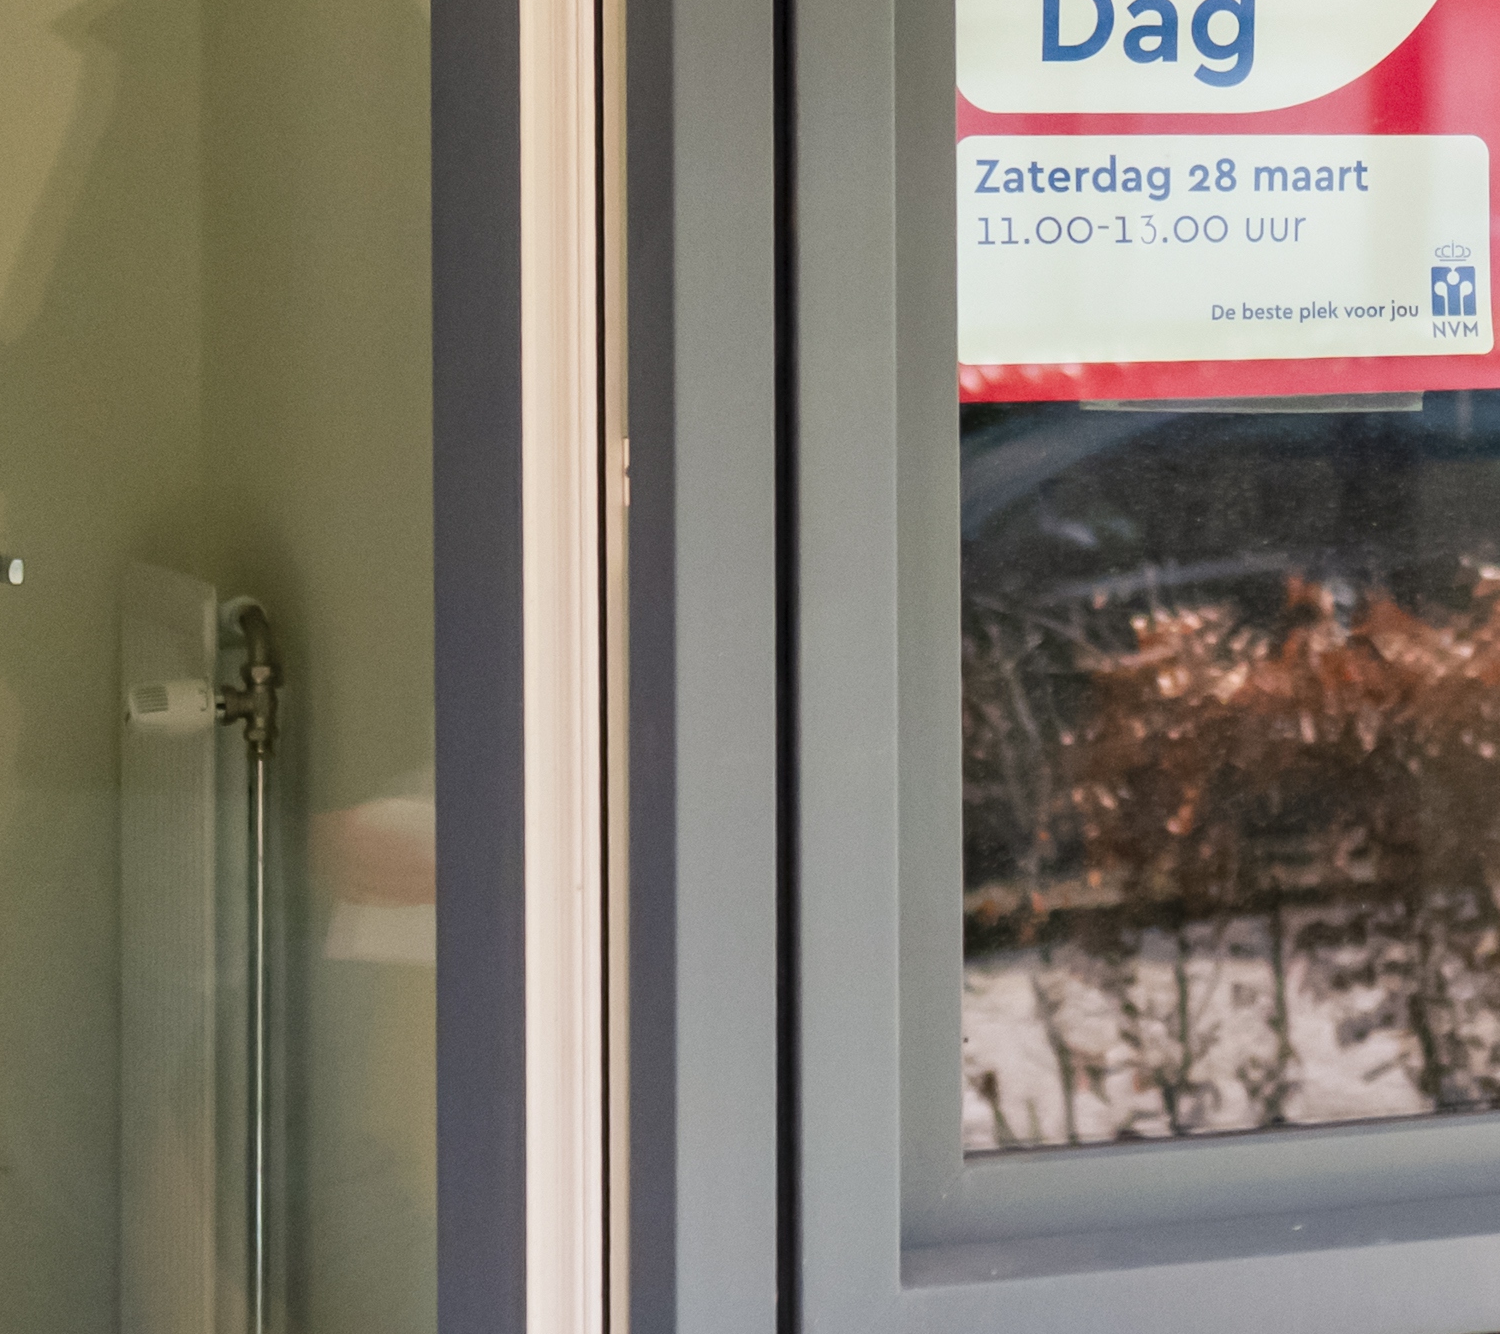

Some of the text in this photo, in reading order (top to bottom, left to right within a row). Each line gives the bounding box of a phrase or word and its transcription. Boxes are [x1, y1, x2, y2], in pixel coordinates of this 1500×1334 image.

[974, 154, 1369, 201] Zaterdag 28 maart
[977, 215, 1306, 245] 11.00-13.00 uur
[1211, 300, 1419, 323] De beste plek voor jou
[1432, 321, 1479, 338] NVM
